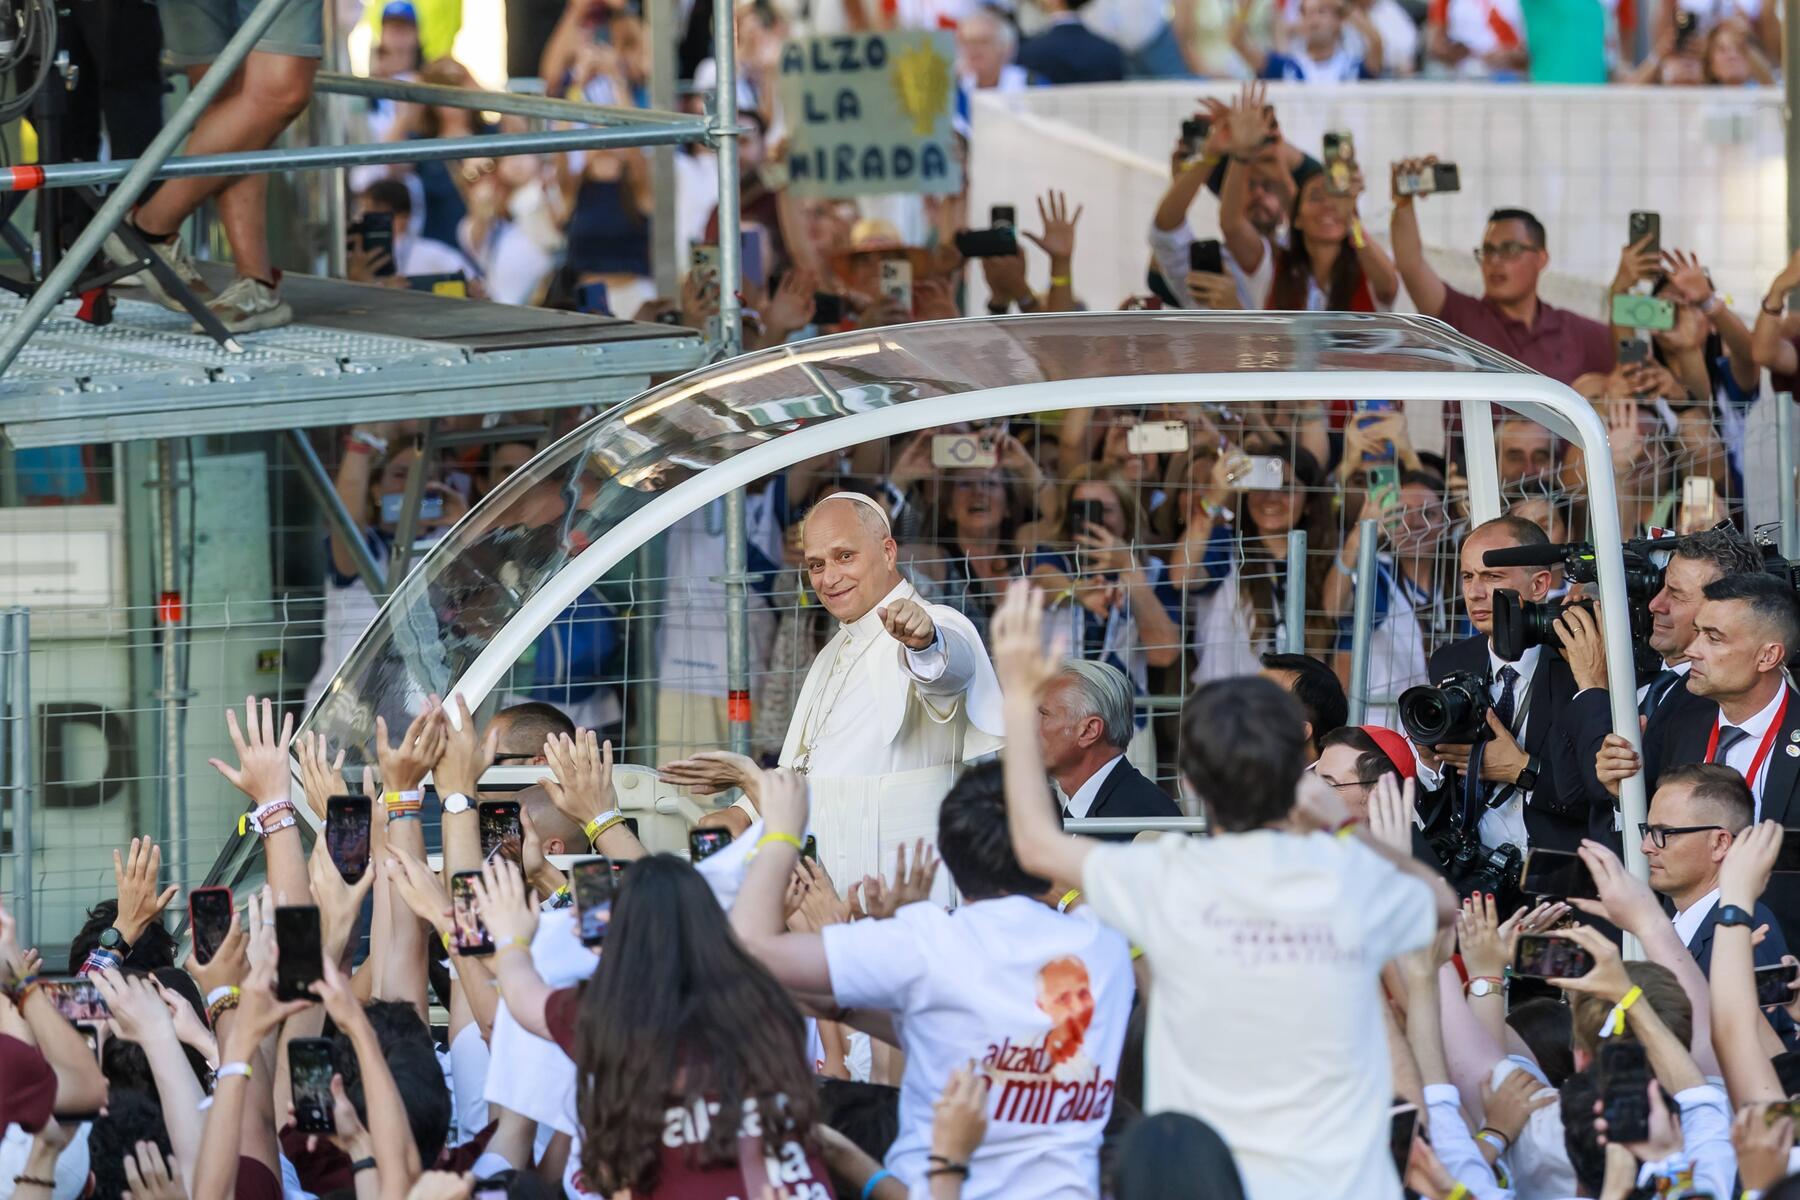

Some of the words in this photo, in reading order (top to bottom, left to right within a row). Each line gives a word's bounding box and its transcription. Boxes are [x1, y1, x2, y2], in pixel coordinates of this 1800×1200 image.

[782, 34, 886, 76] ALZO
[804, 87, 861, 124] LA
[789, 142, 947, 184] MIRADA
[994, 1065, 1115, 1124] mirada
